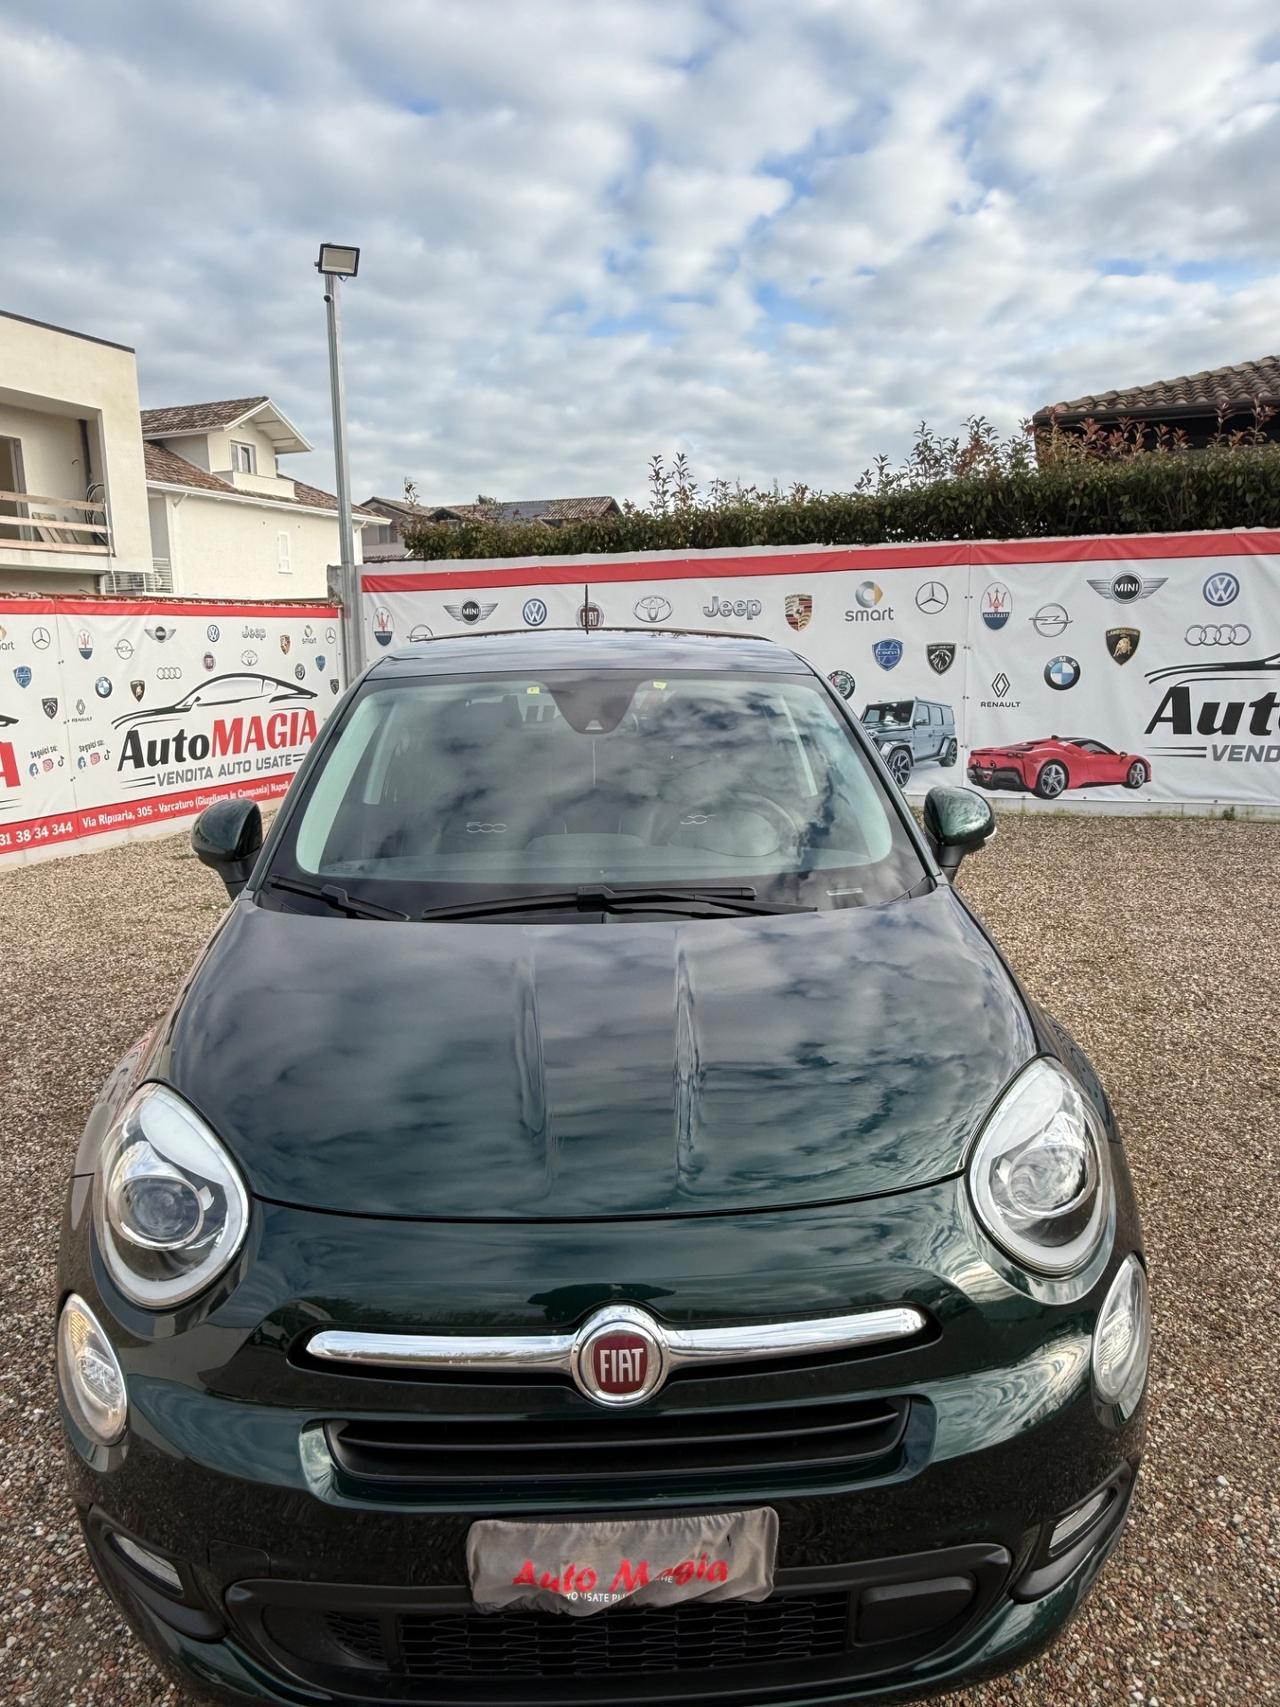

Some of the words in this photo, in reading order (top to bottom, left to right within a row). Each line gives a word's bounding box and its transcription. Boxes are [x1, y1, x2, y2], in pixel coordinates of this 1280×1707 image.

[1114, 582, 1140, 593] MINI
[462, 607, 480, 616] MINI
[581, 611, 599, 627] FAT
[703, 596, 762, 620] Jeep
[844, 608, 895, 623] smart
[242, 625, 267, 641] Jeep
[1144, 687, 1280, 736] Aut
[157, 766, 214, 787] VENDITA
[218, 758, 252, 778] AUTO
[256, 752, 292, 772] USATE
[82, 816, 97, 829] Via
[98, 809, 136, 827] Ripuaria,
[136, 805, 153, 819] 305
[158, 798, 195, 813] Varcaturo
[16, 828, 31, 844] 38
[34, 825, 49, 840] 34
[52, 821, 74, 836] 344
[600, 1347, 644, 1384] FIAT
[512, 1558, 597, 1594] Auto
